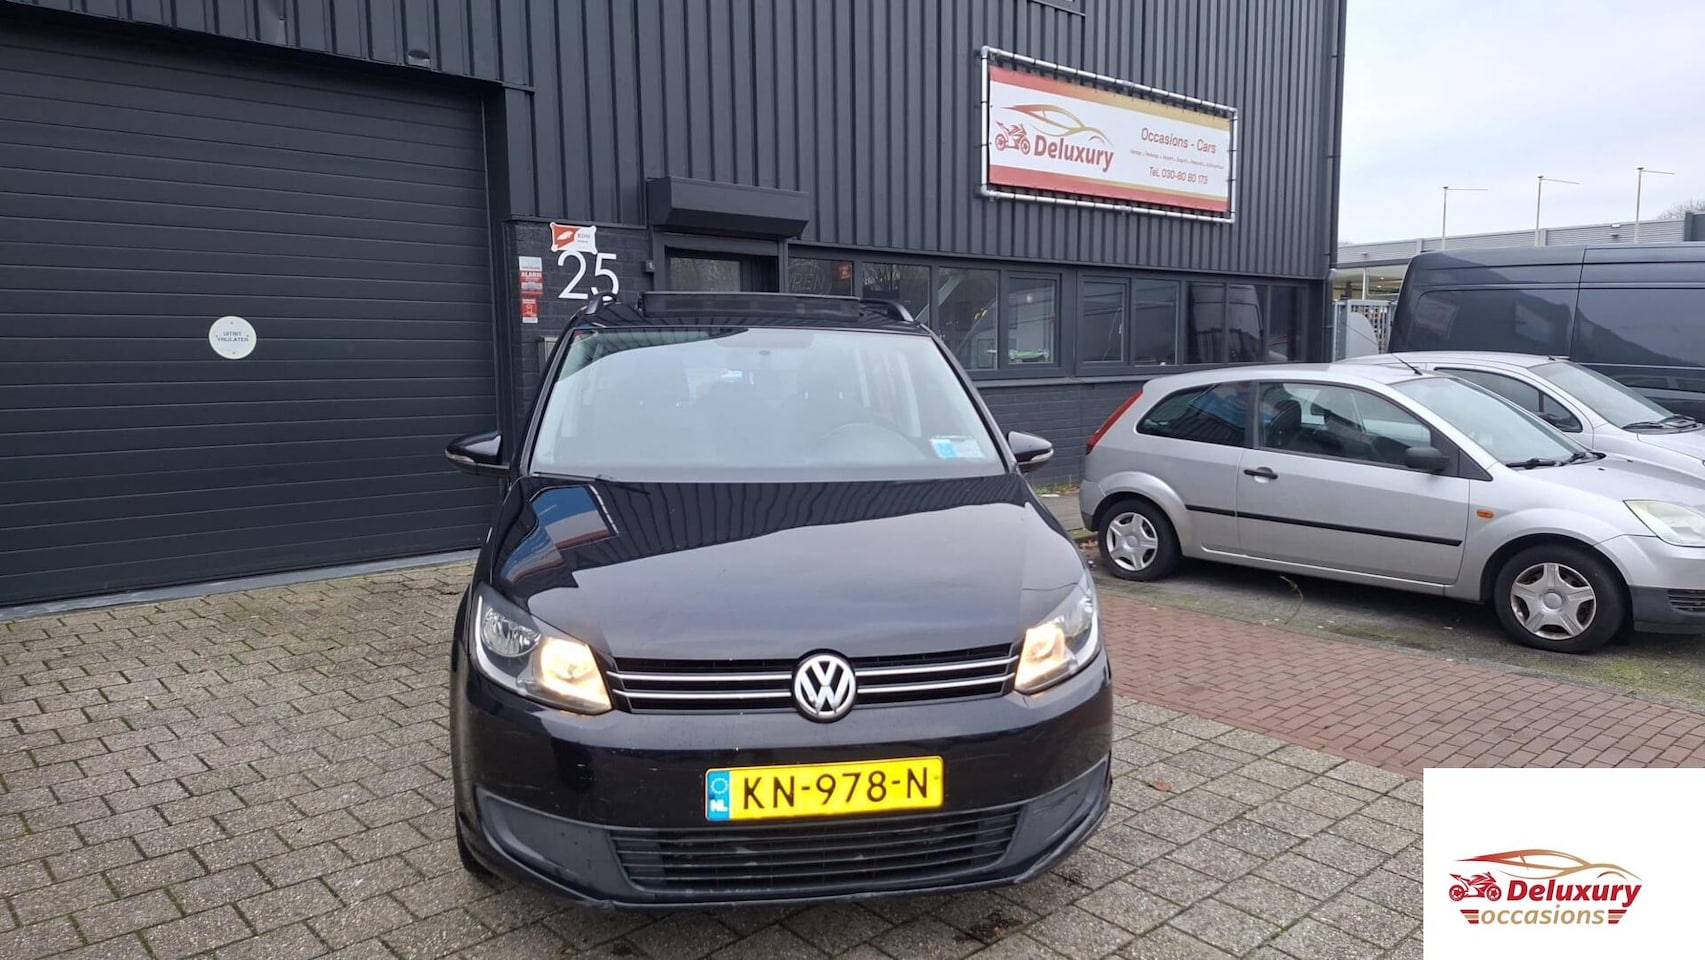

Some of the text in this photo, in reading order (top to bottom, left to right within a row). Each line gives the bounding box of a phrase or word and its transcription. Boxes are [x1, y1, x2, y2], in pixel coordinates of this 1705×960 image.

[1033, 134, 1114, 173] Deluxury
[1141, 127, 1188, 149] Occasions
[1197, 138, 1216, 154] Cars
[1187, 174, 1197, 183] 80
[558, 250, 619, 301] 25
[743, 766, 928, 810] KN-978-N
[710, 799, 729, 812] NL
